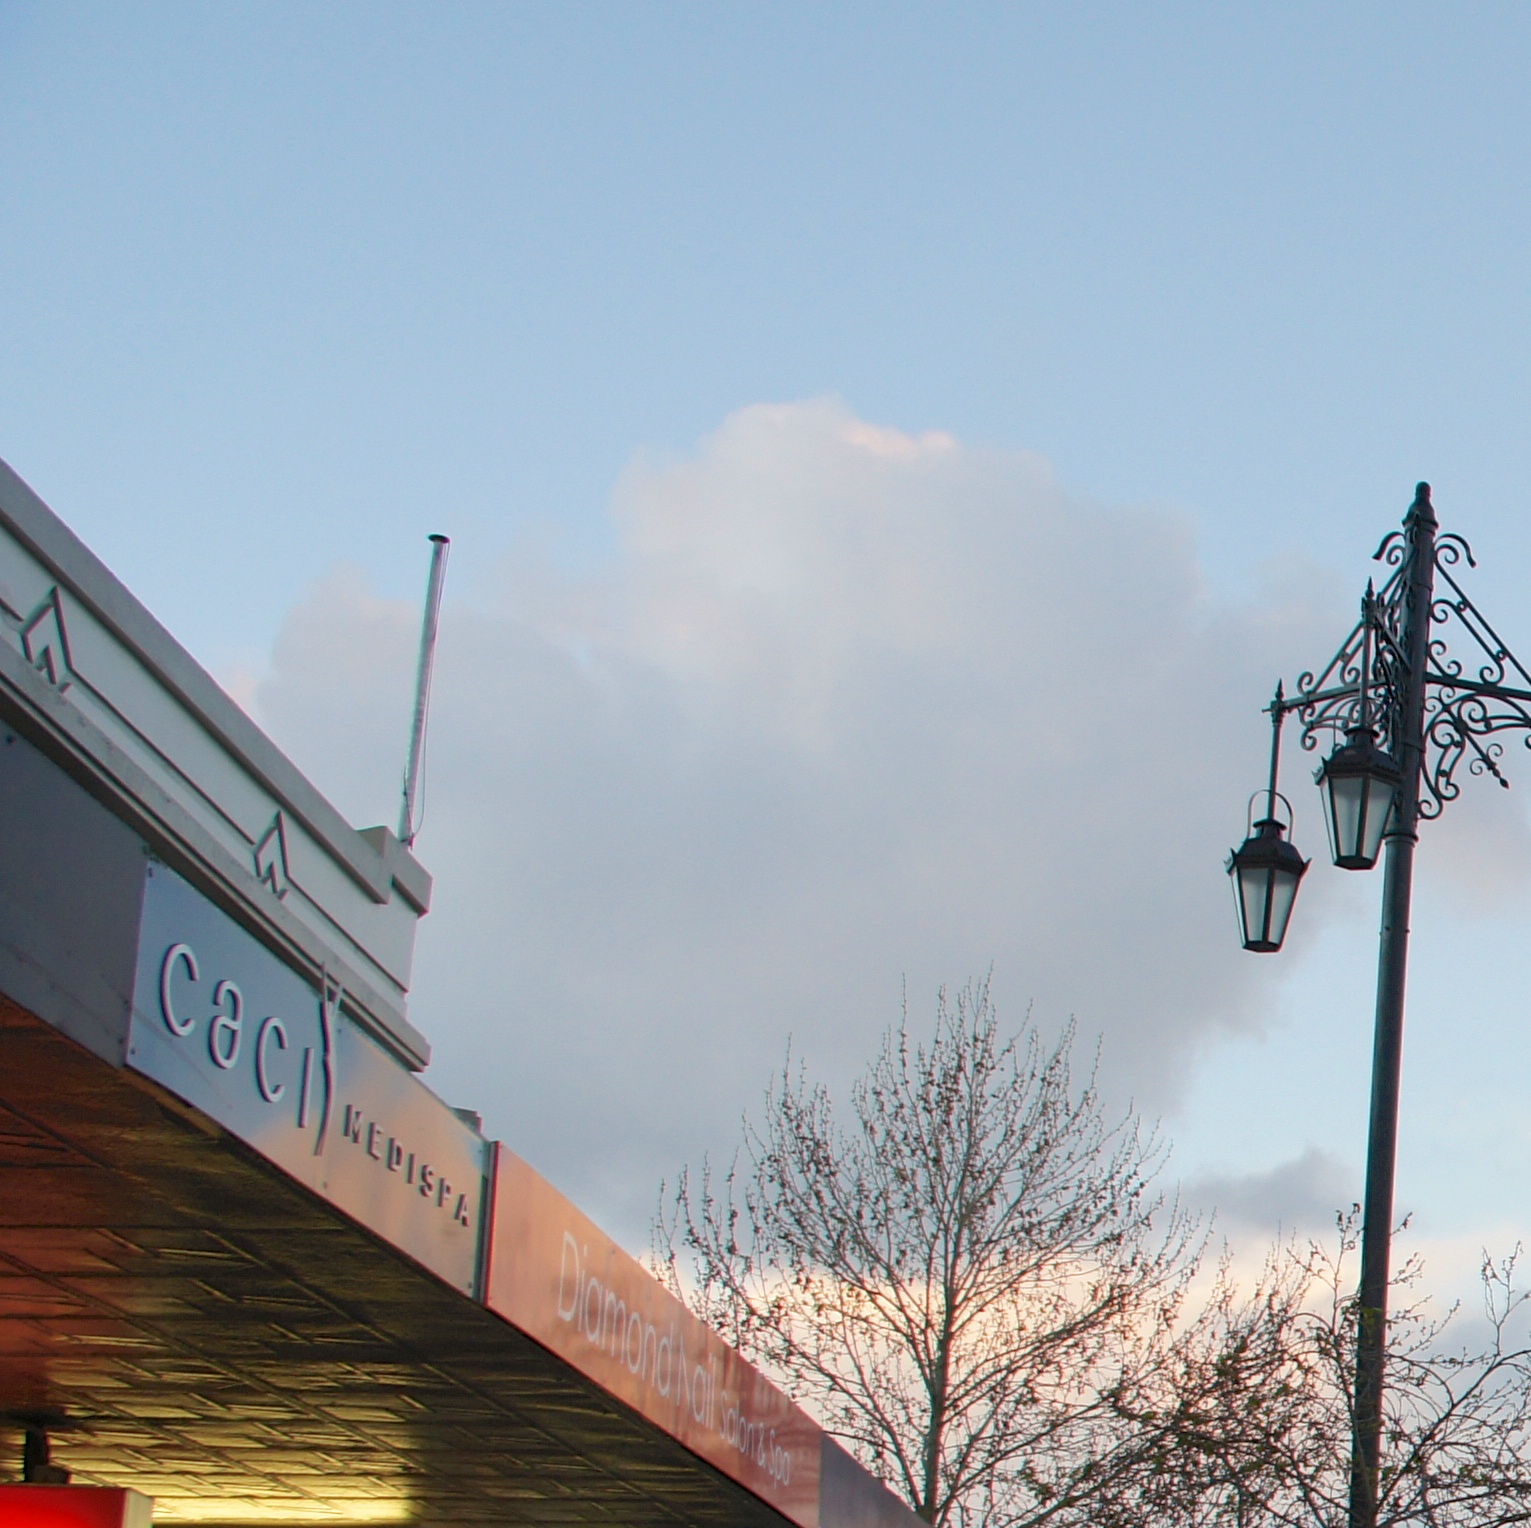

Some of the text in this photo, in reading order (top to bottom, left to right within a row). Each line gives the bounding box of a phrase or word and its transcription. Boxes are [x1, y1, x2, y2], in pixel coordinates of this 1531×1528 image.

[344, 1103, 471, 1227] MEDISPA
[557, 1231, 792, 1488] Diamond Nail Salon & Spa
